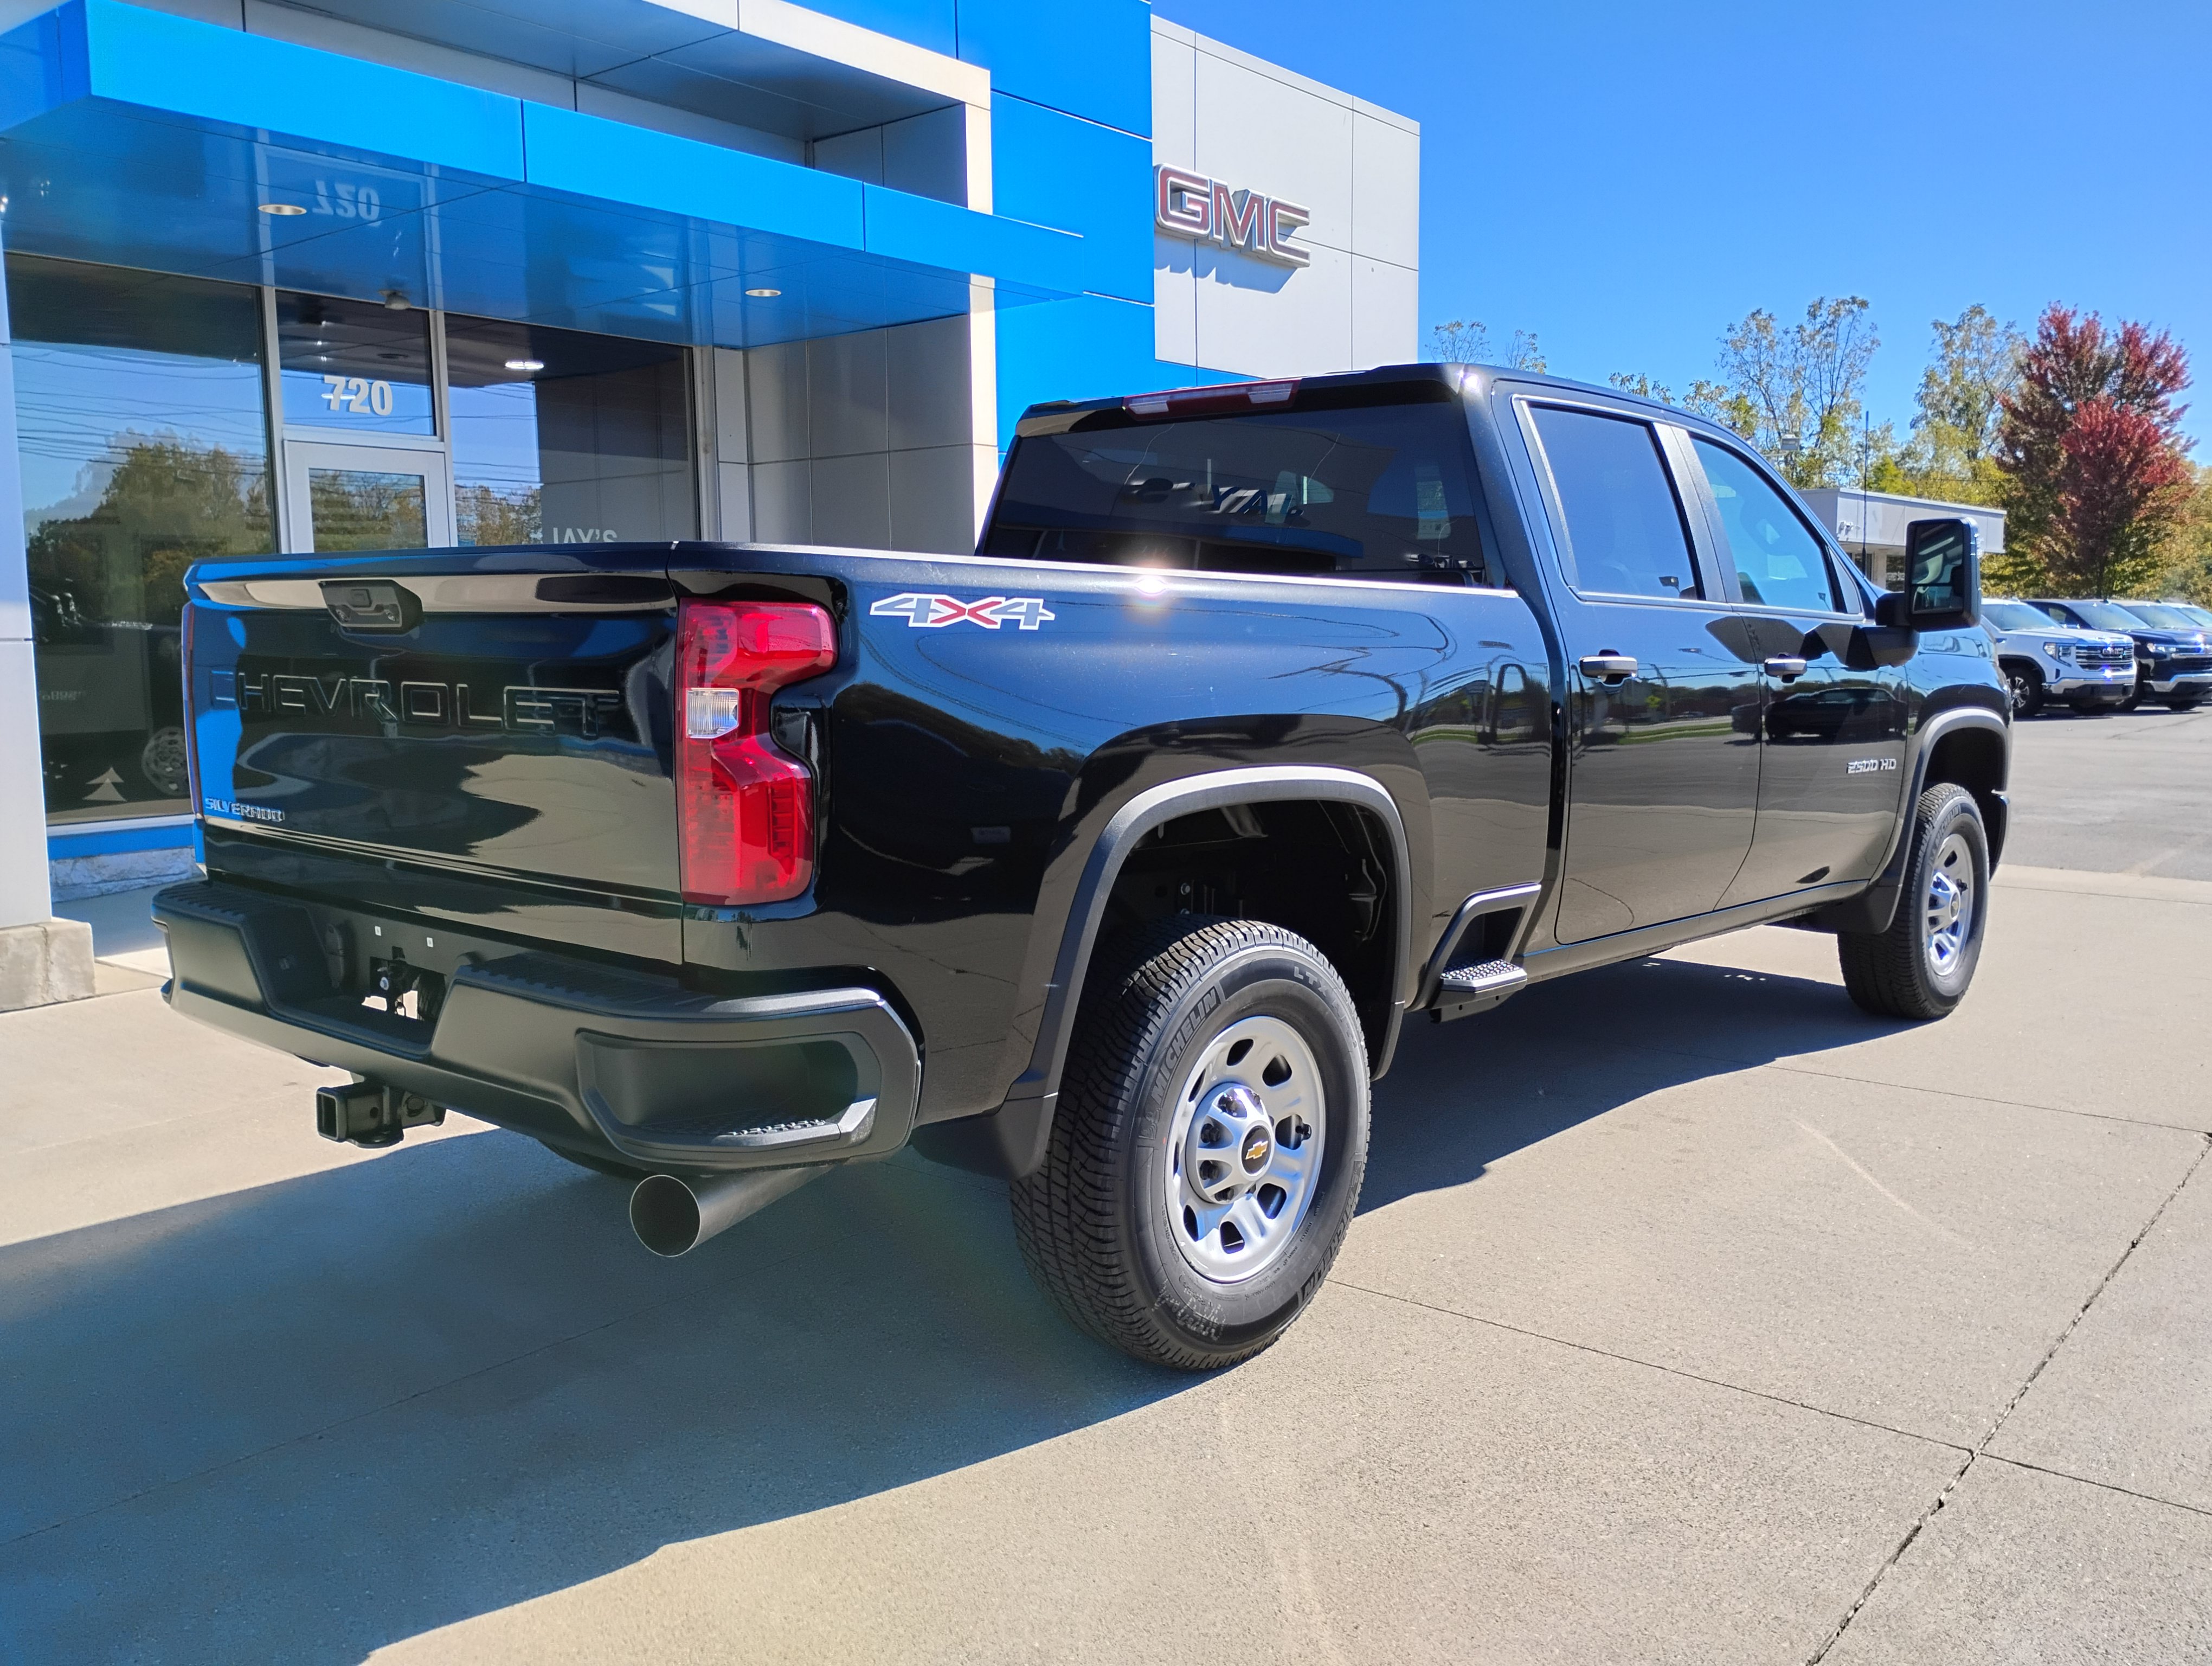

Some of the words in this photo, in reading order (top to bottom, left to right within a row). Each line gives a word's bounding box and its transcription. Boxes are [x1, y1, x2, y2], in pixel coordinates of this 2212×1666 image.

[1154, 164, 1311, 267] GMC
[324, 375, 393, 416] 720
[210, 670, 620, 736] CHEVROLET
[1846, 759, 1878, 774] 2500
[1879, 759, 1896, 771] HD
[204, 797, 286, 822] SILVERADO
[1294, 966, 1329, 997] LTX
[1150, 985, 1218, 1105] MICHELIN
